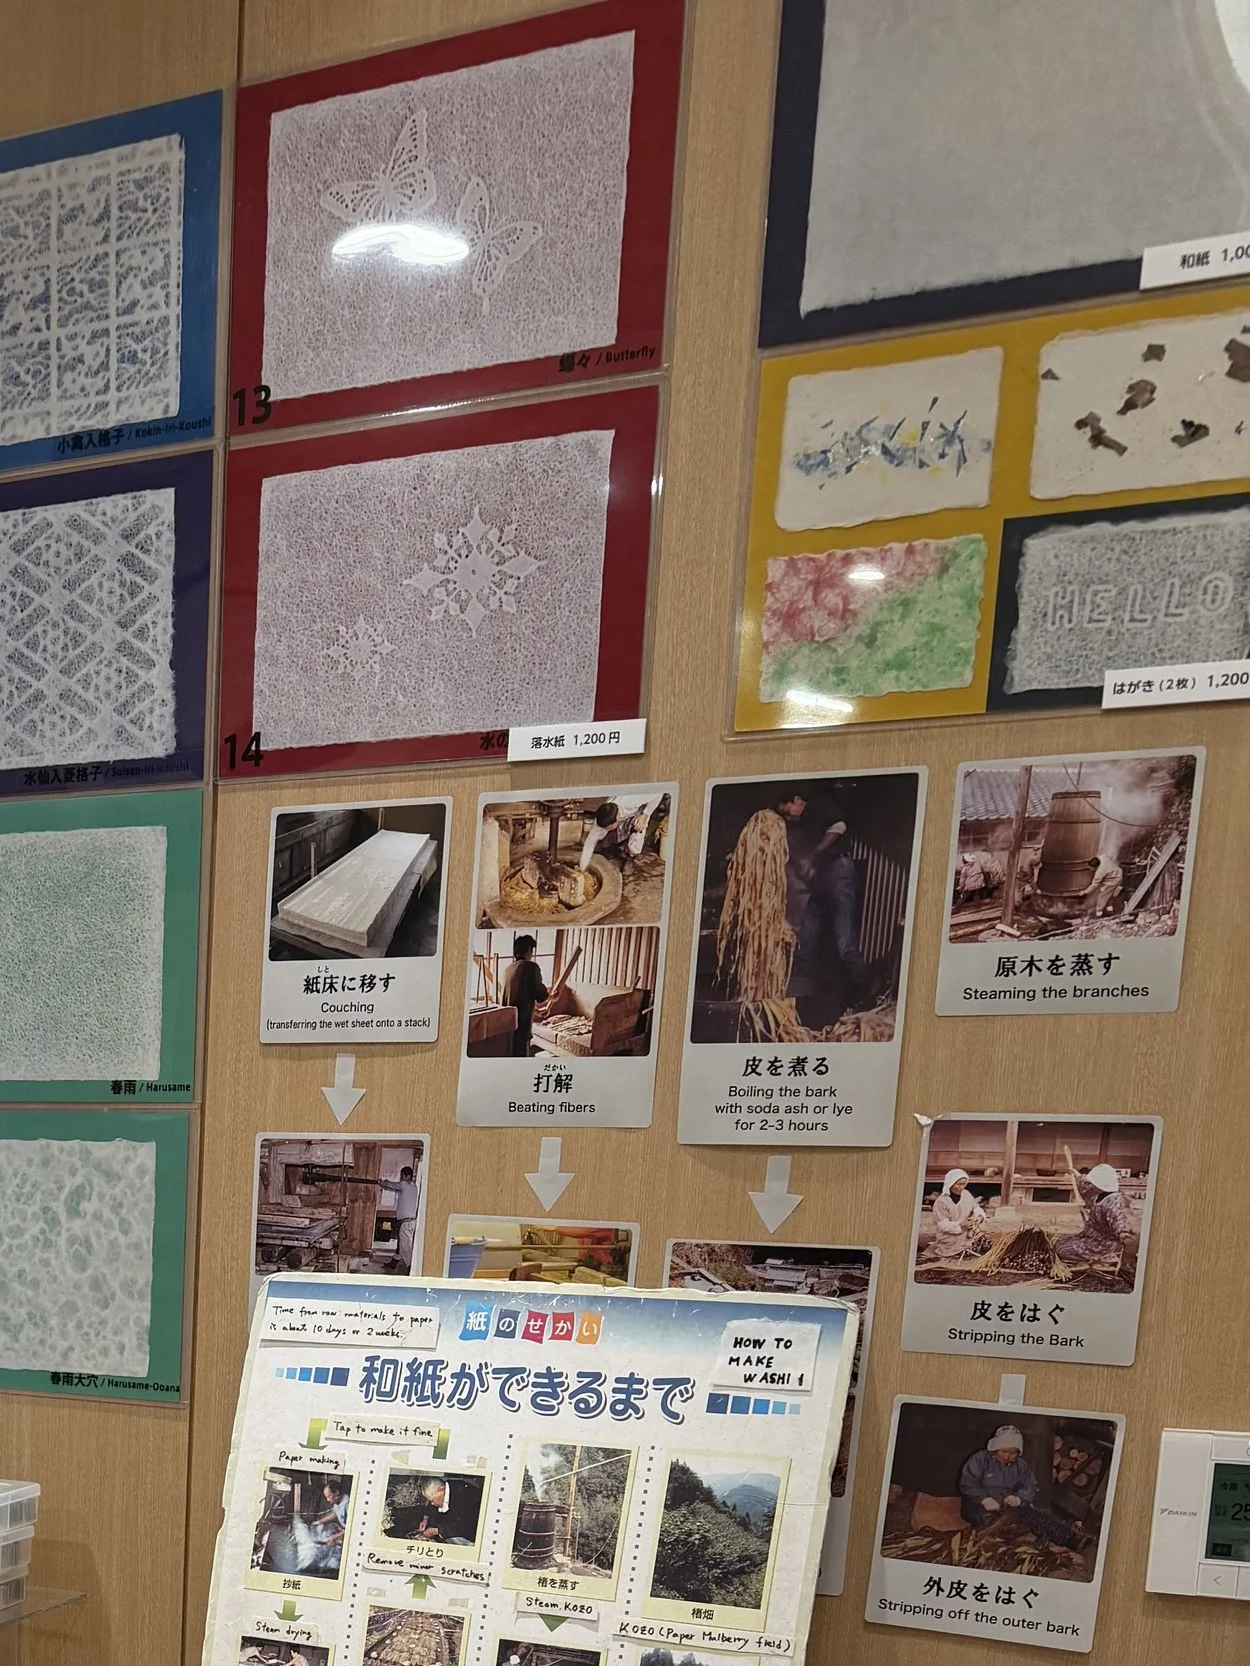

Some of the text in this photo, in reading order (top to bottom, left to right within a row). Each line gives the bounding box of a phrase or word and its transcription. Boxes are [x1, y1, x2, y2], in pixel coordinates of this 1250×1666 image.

[1180, 251, 1210, 270] 和紙
[605, 344, 656, 365] Butterfly
[233, 384, 272, 427] 13
[1049, 570, 1235, 630] HELLO
[1207, 672, 1250, 688] 1,200
[223, 731, 264, 770] 14
[530, 730, 621, 751] 落水紙 1,200円
[24, 765, 103, 787] 水仙入菱格子
[994, 951, 1121, 978] 原木を蒸す
[303, 973, 396, 995] 紙床に移す
[962, 984, 1150, 1003] Steaming the branches
[321, 1002, 375, 1014] Couching
[266, 1018, 317, 1031] (transferring
[319, 1018, 332, 1028] the
[334, 1019, 349, 1028] wet
[351, 1018, 374, 1028] sheet
[376, 1018, 394, 1027] onto
[404, 1017, 431, 1028] stack)
[544, 1063, 567, 1072] だかい
[741, 1055, 831, 1078] 皮を煮る
[110, 1079, 191, 1096] 春雨 Harusame
[533, 1072, 574, 1094] 打解
[728, 1084, 838, 1100] Boiling the bark
[508, 1100, 596, 1115] Beating fibers
[715, 1102, 853, 1118] with soda ash or lye
[734, 1119, 756, 1132] for
[790, 1119, 829, 1133] hours
[970, 1299, 1066, 1325] 皮をはぐ
[465, 1310, 599, 1337] 紙のせかい
[733, 1336, 793, 1350] HOW TO
[947, 1328, 1085, 1348] Stripping the Bark
[728, 1355, 775, 1369] MAKE
[50, 1370, 181, 1393] 春雨大穴 Harusame-Ooana
[743, 1371, 791, 1385] WASHI
[359, 1354, 696, 1426] 和紙ができるまで
[333, 1420, 434, 1438] Tap to make it fine
[278, 1450, 341, 1471] Paper making
[923, 1575, 1039, 1609] 外皮をはぐ
[878, 1598, 1081, 1638] Stripping off the outer bark
